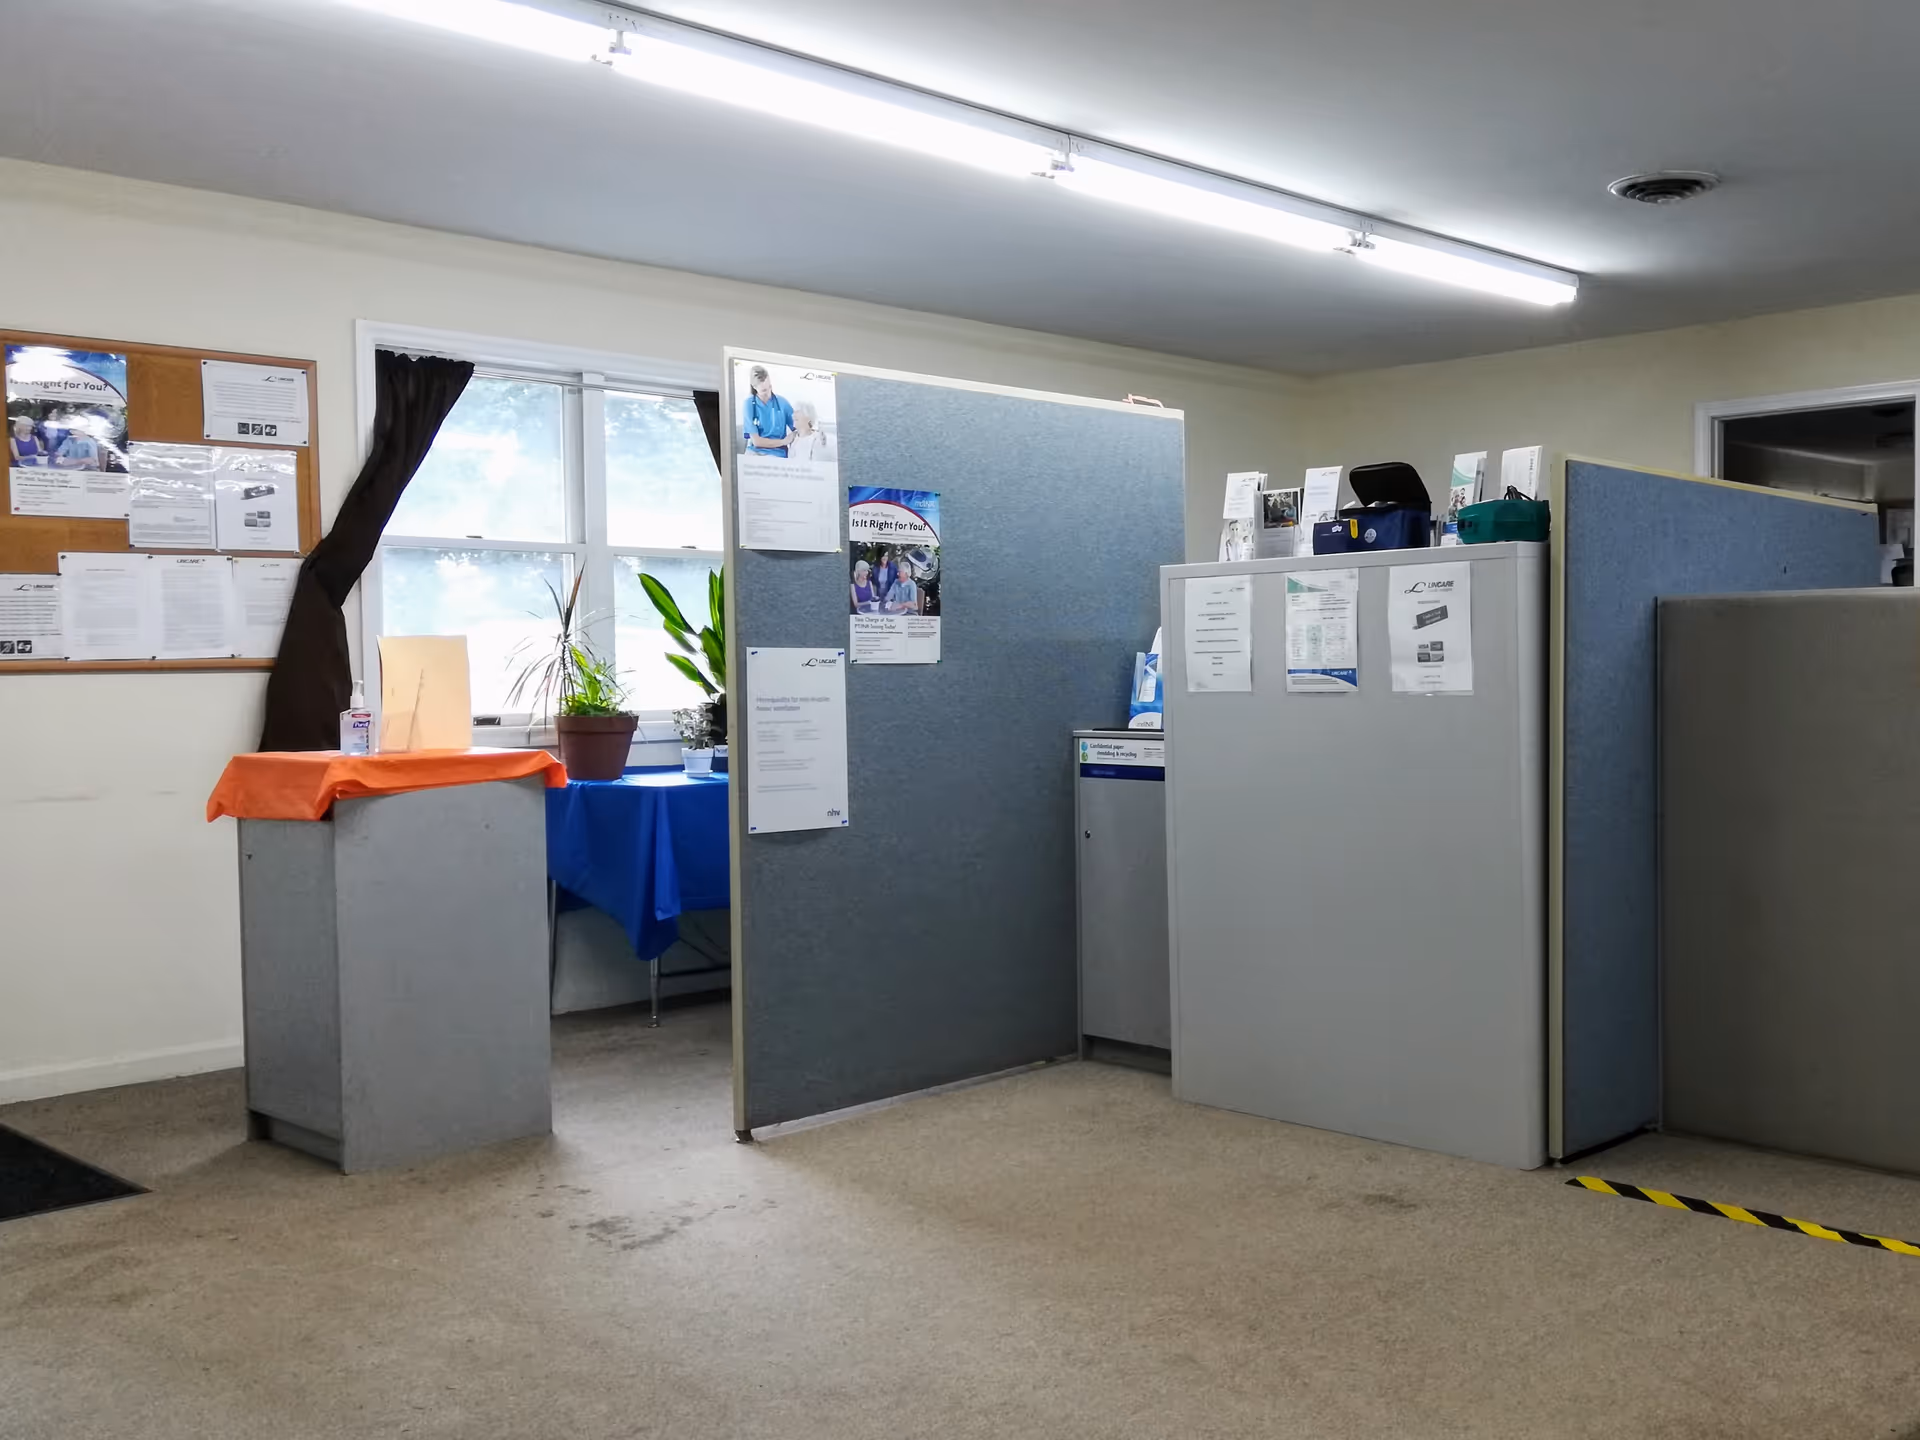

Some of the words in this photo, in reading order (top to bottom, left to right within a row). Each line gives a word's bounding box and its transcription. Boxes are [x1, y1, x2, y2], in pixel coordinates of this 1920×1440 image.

[63, 380, 81, 390] for
[82, 381, 108, 391] You?
[852, 518, 861, 528] Is
[860, 519, 868, 528] It
[869, 519, 893, 531] Right
[894, 520, 908, 532] for
[908, 521, 927, 531] You?
[1427, 580, 1454, 589] LINCARE
